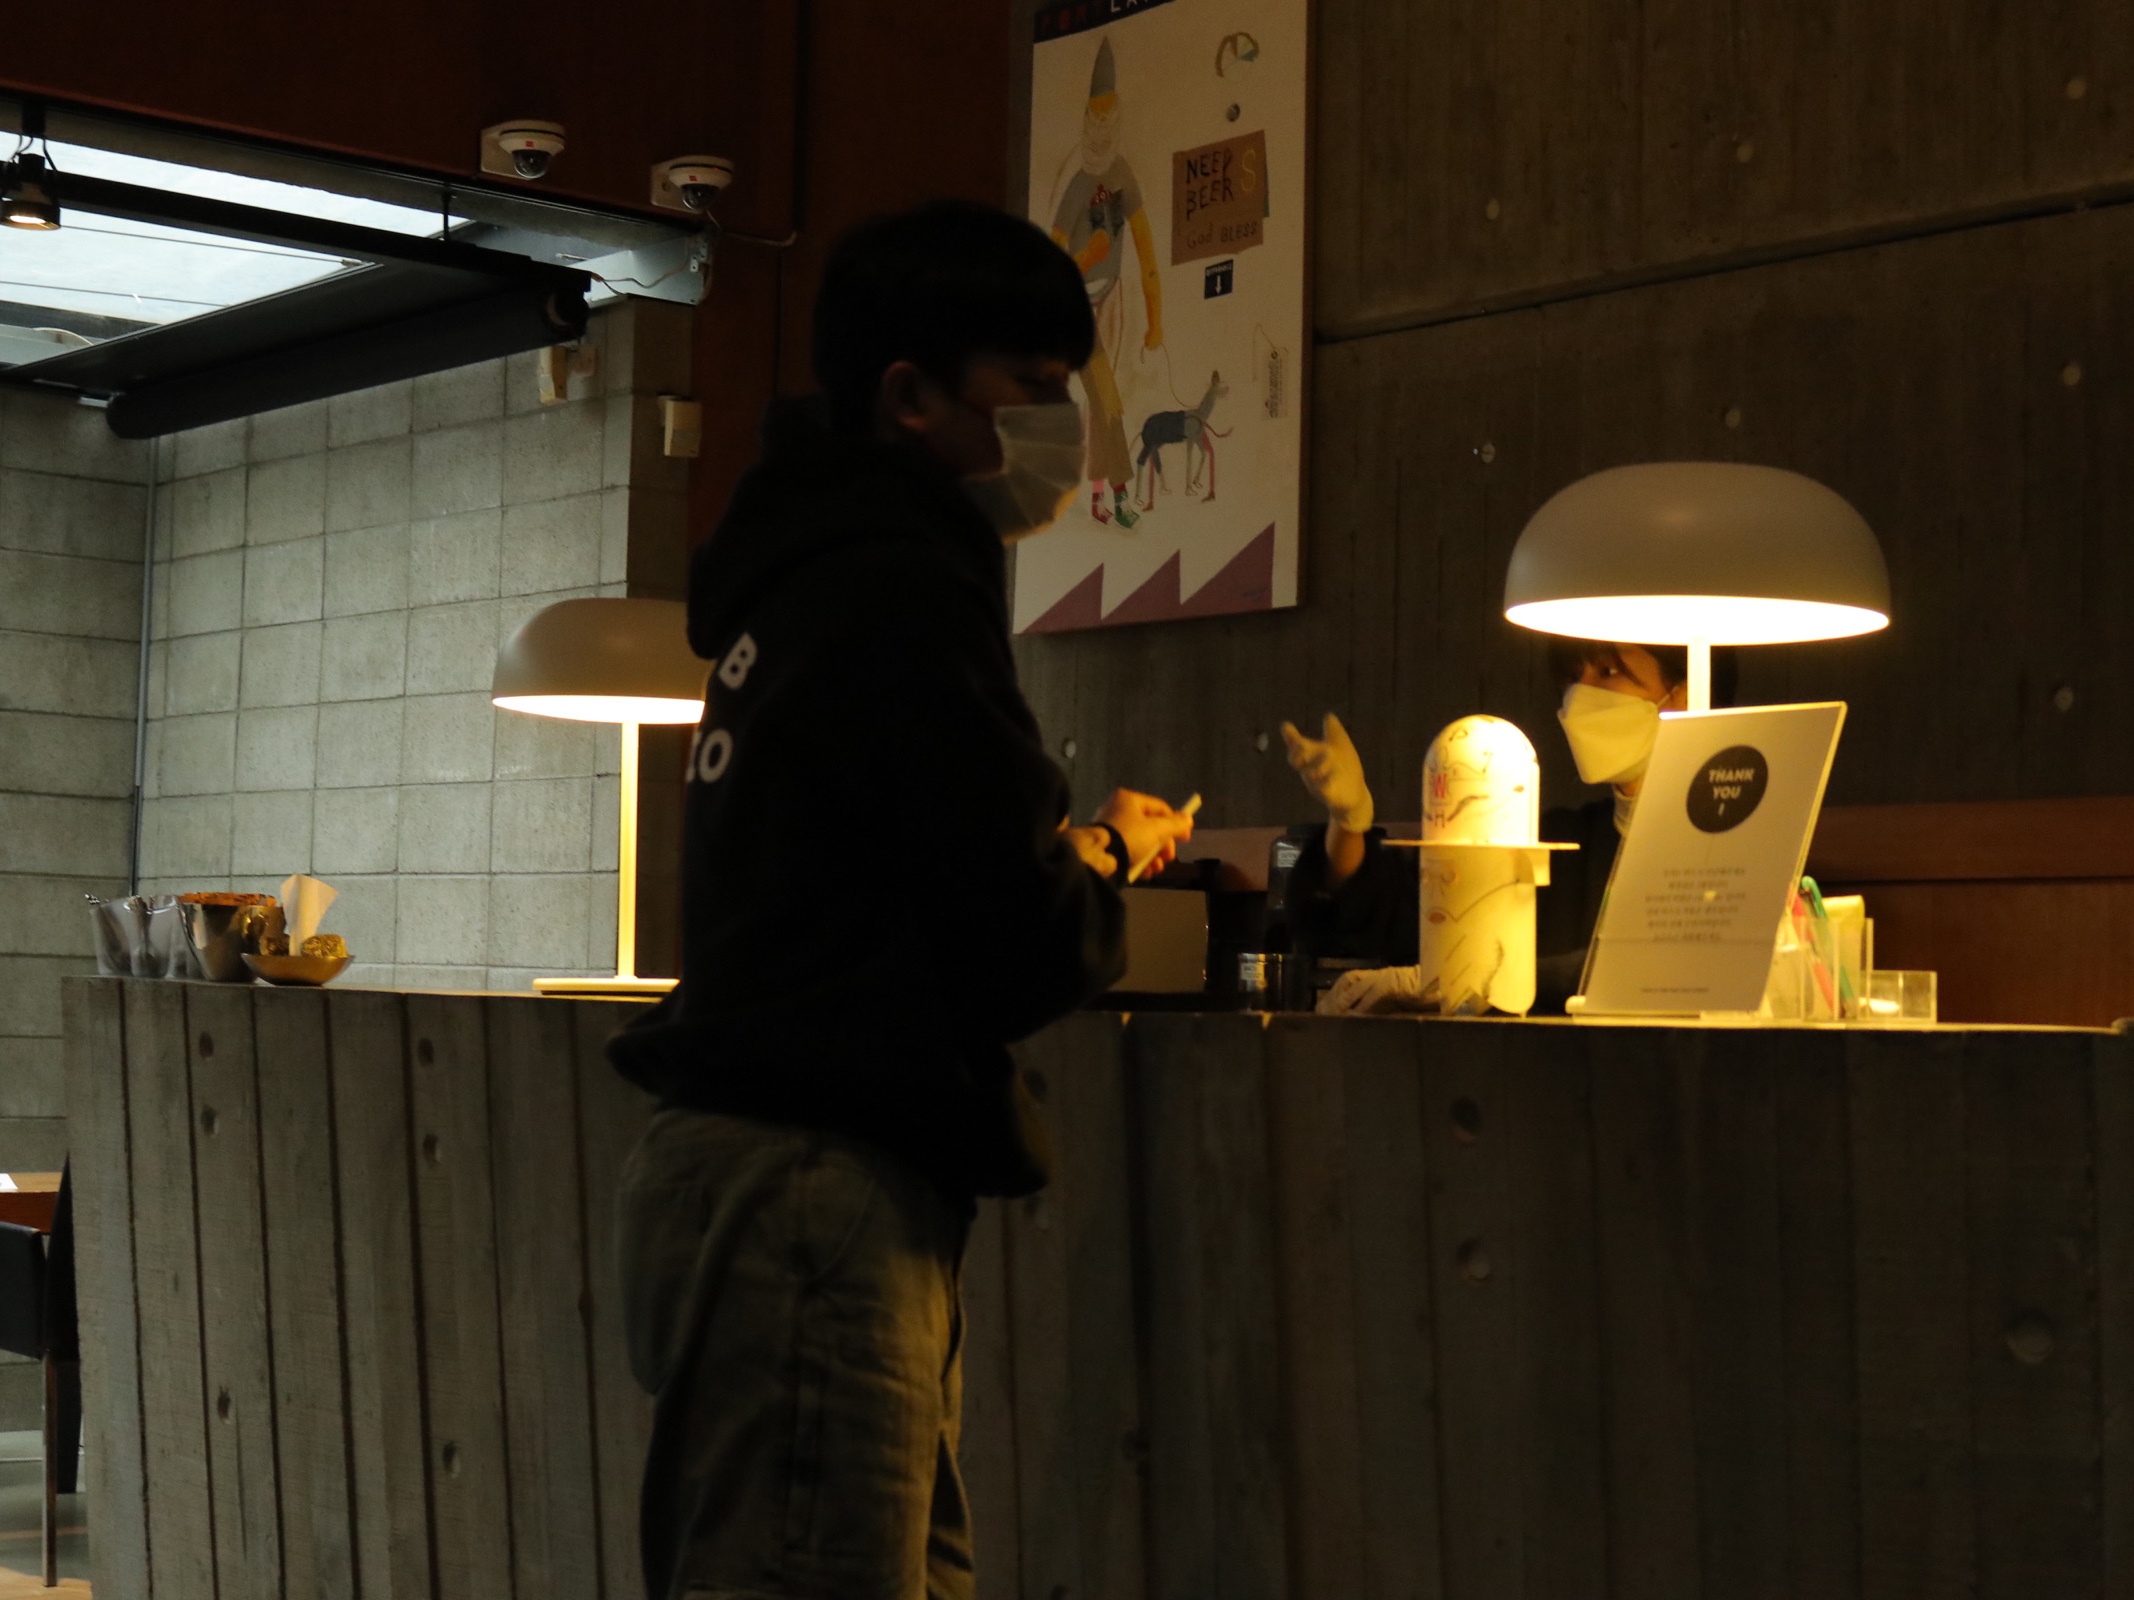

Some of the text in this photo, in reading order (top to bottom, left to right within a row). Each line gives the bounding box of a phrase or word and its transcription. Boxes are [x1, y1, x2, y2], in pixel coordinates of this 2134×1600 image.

[1186, 177, 1234, 221] BEER
[1220, 220, 1258, 243] BLESS
[718, 631, 759, 690] B
[1708, 767, 1756, 783] THANK
[1713, 785, 1742, 800] YOU
